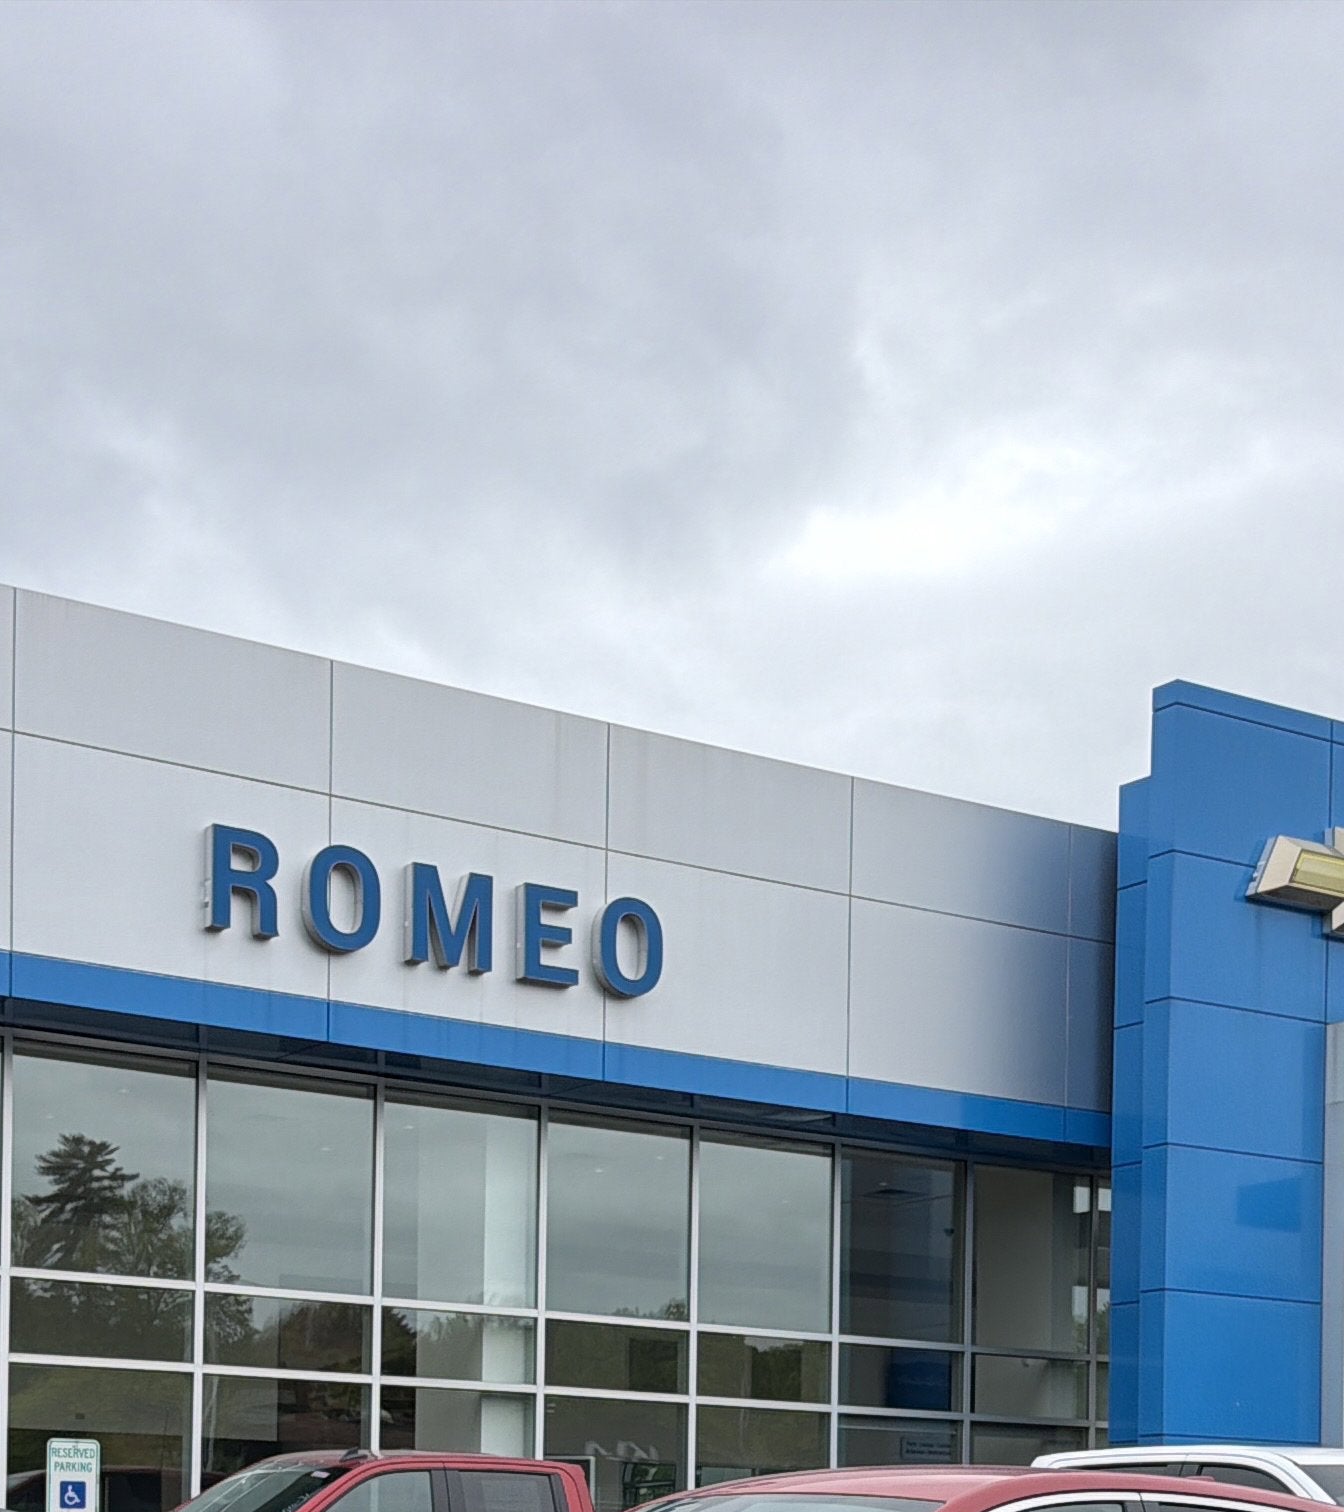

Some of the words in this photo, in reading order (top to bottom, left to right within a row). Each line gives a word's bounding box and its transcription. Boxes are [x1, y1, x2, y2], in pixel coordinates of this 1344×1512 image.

[204, 823, 663, 998] ROMEO
[51, 1447, 96, 1459] RESERVED
[54, 1461, 93, 1473] PARKING
